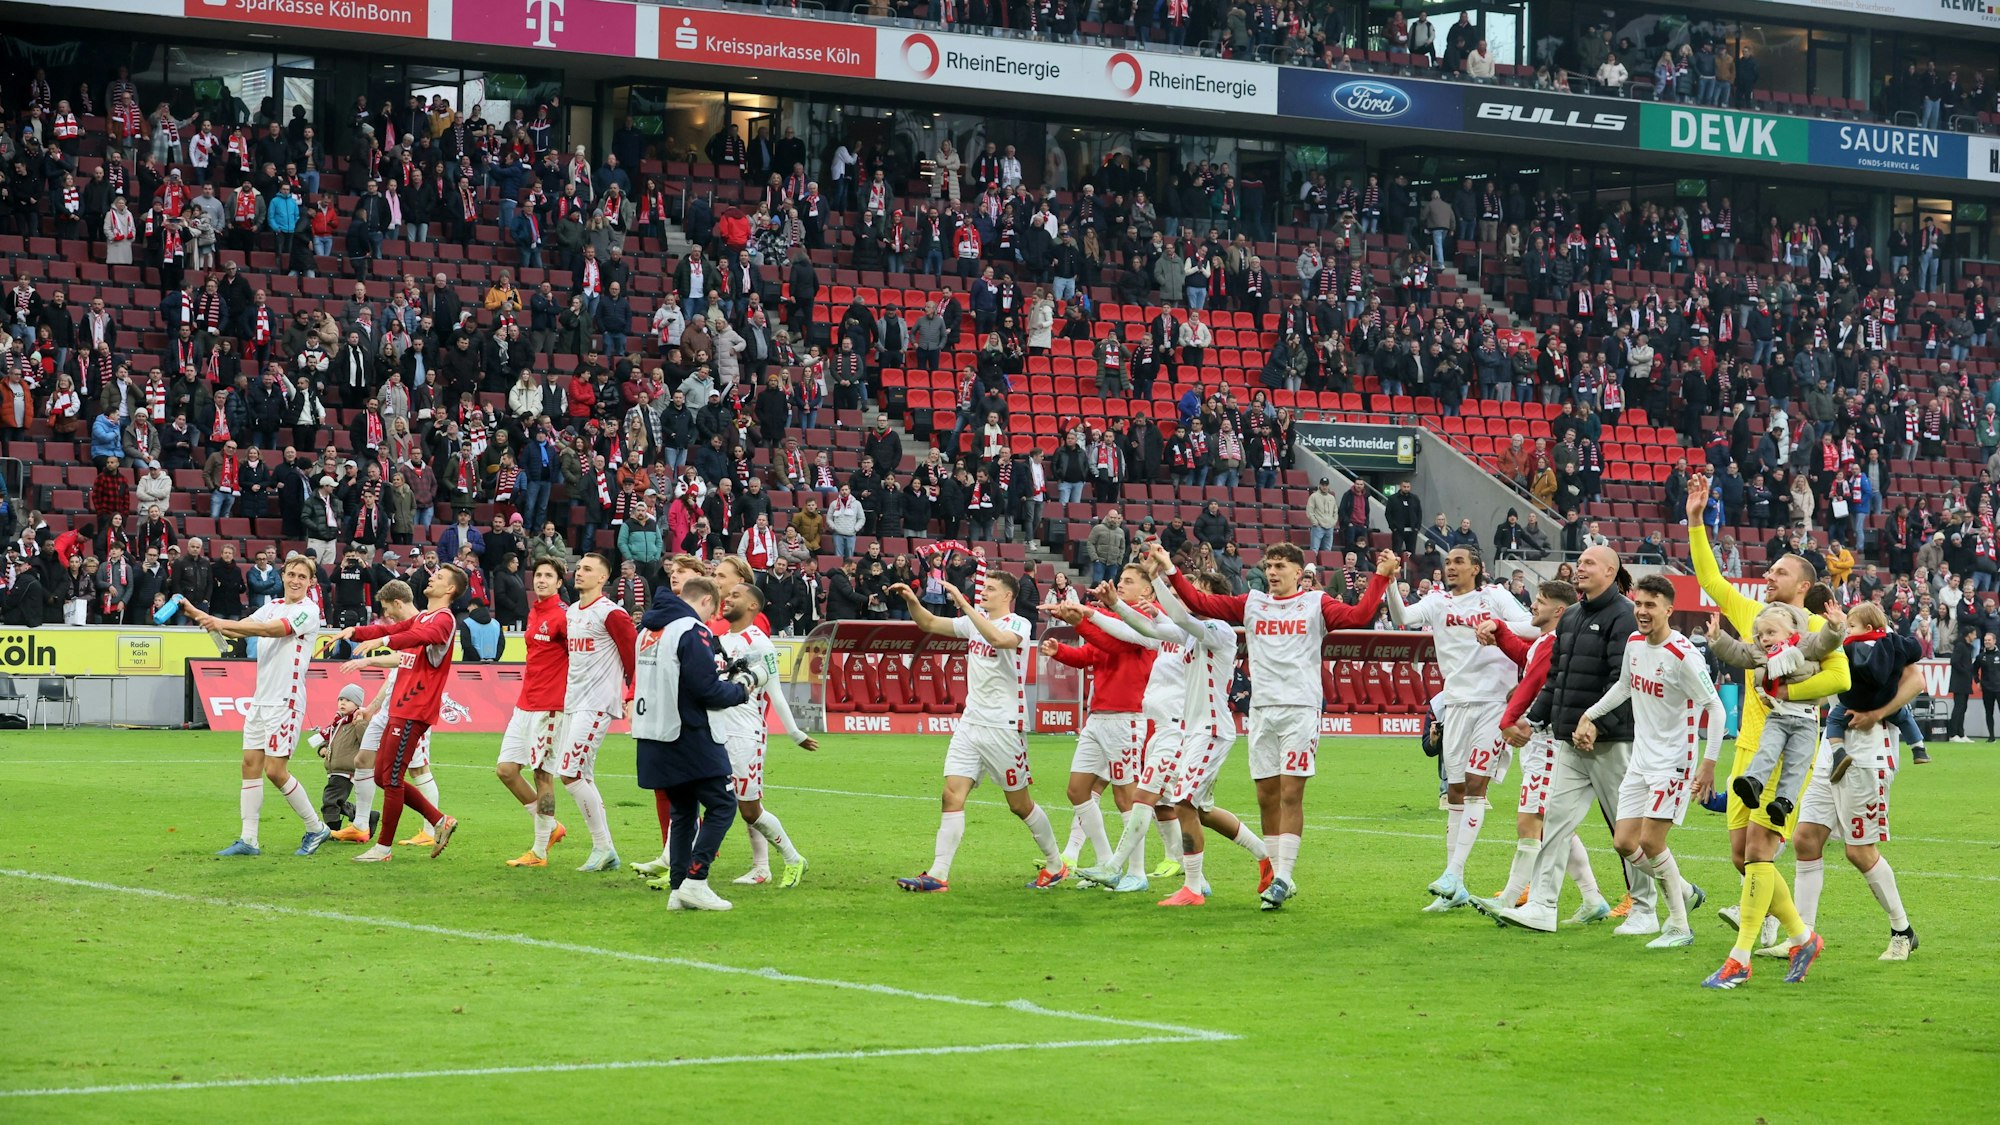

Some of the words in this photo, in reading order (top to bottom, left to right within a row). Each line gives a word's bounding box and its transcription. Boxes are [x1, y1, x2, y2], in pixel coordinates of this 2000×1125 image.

[329, 1, 412, 24] KölnBonn
[706, 35, 822, 62] Kreissparkasse
[827, 47, 860, 65] Köln
[946, 51, 1060, 80] RheinEnergie
[1149, 70, 1257, 99] RheinEnergie
[1347, 85, 1396, 113] Ford
[1476, 102, 1628, 132] BULLS
[1670, 110, 1778, 157] DEVK
[1840, 125, 1939, 159] SAUREN
[1858, 158, 1909, 170] FONDS-SERVICE
[1910, 163, 1920, 171] AG
[1338, 436, 1396, 451] Schneider
[341, 572, 361, 581] REWE
[1255, 619, 1307, 636] REWE
[0, 635, 57, 667] öln
[567, 638, 596, 652] EWE
[870, 640, 915, 650] REWE
[926, 640, 969, 651] REWE
[1324, 645, 1362, 657] REWE
[1373, 646, 1411, 658] REWE
[1630, 672, 1664, 698] REWE
[844, 715, 891, 731] REWE
[928, 717, 960, 732] REW
[1042, 710, 1072, 726] REWE
[1320, 718, 1352, 732] EWE
[1383, 718, 1420, 733] REWE
[268, 734, 278, 752] 4
[1286, 751, 1309, 772] 24
[1469, 748, 1490, 771] 42
[1005, 768, 1017, 787] 6
[1109, 761, 1124, 780] 16
[1652, 790, 1665, 812] 7
[1851, 817, 1865, 839] 3
